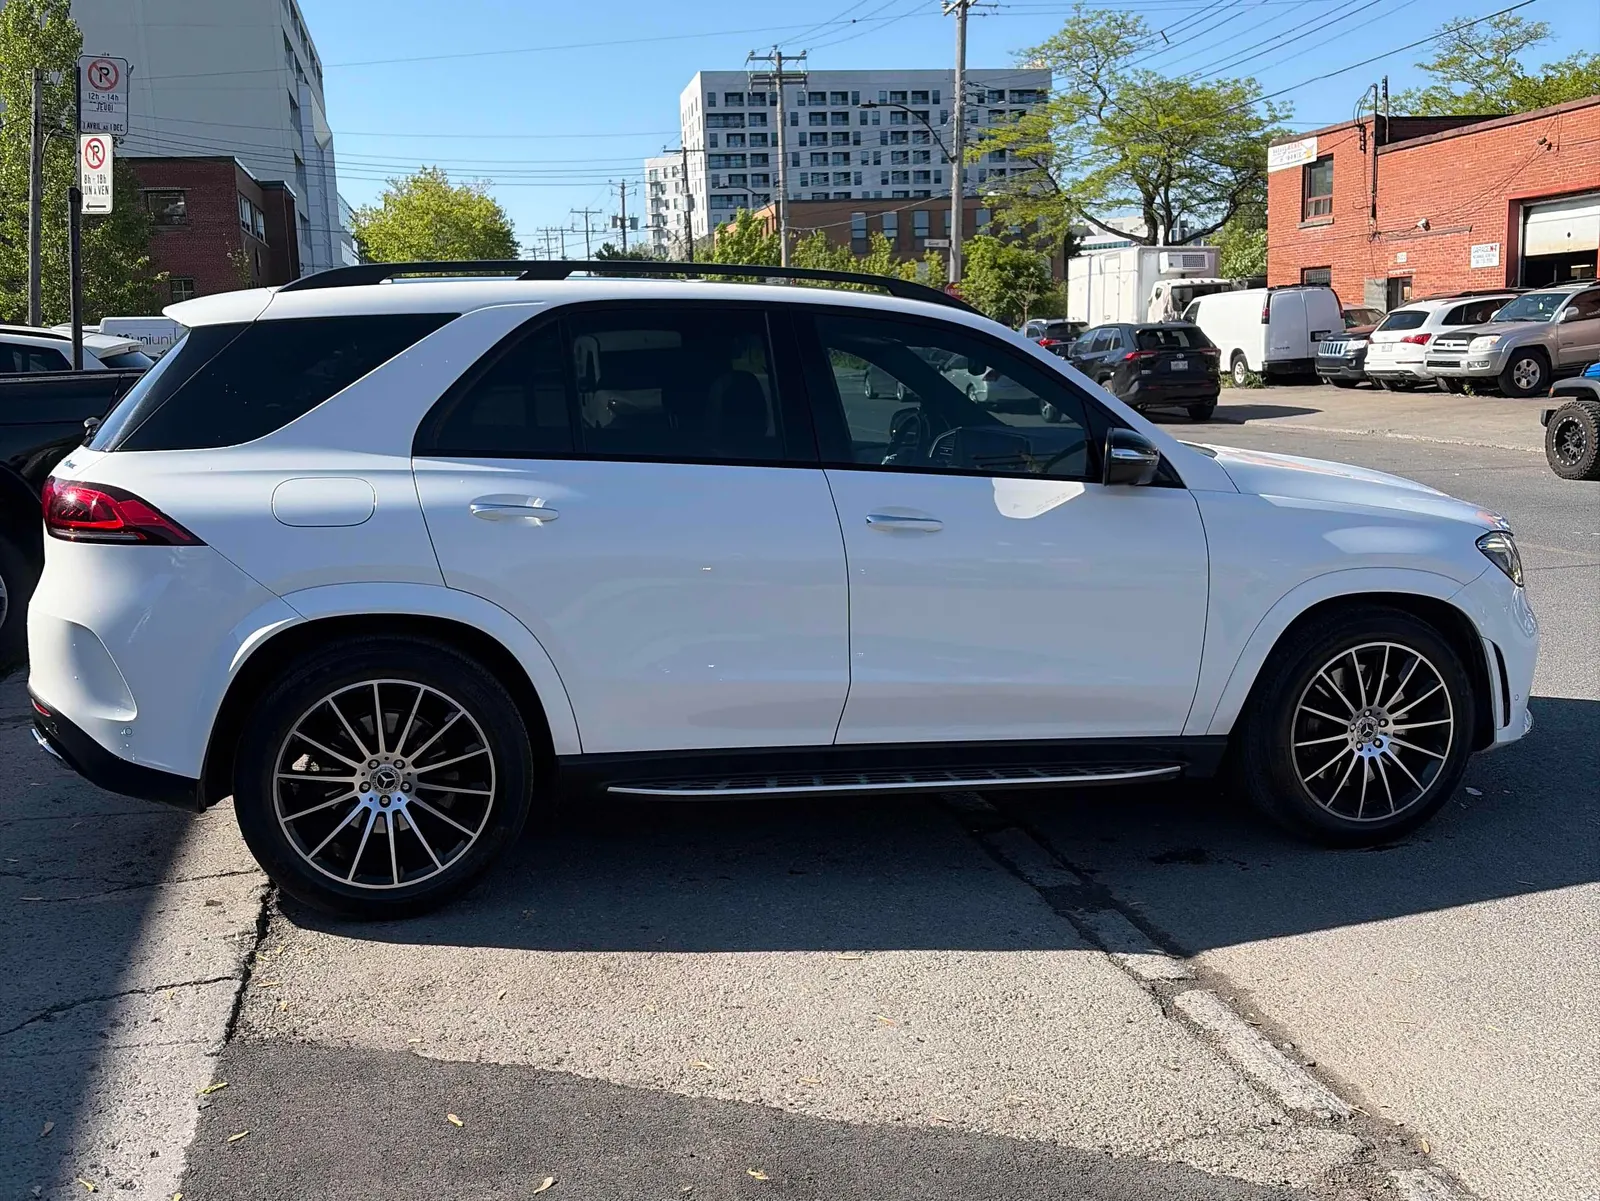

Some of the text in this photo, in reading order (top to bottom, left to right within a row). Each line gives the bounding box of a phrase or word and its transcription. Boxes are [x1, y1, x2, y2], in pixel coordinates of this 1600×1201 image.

[88, 92, 100, 100] 12h
[107, 93, 119, 101] 14h
[96, 102, 114, 112] JEUDI
[87, 122, 101, 131] AVRIL
[84, 174, 91, 184] 8h
[97, 174, 107, 184] 18h
[97, 185, 110, 195] VEN
